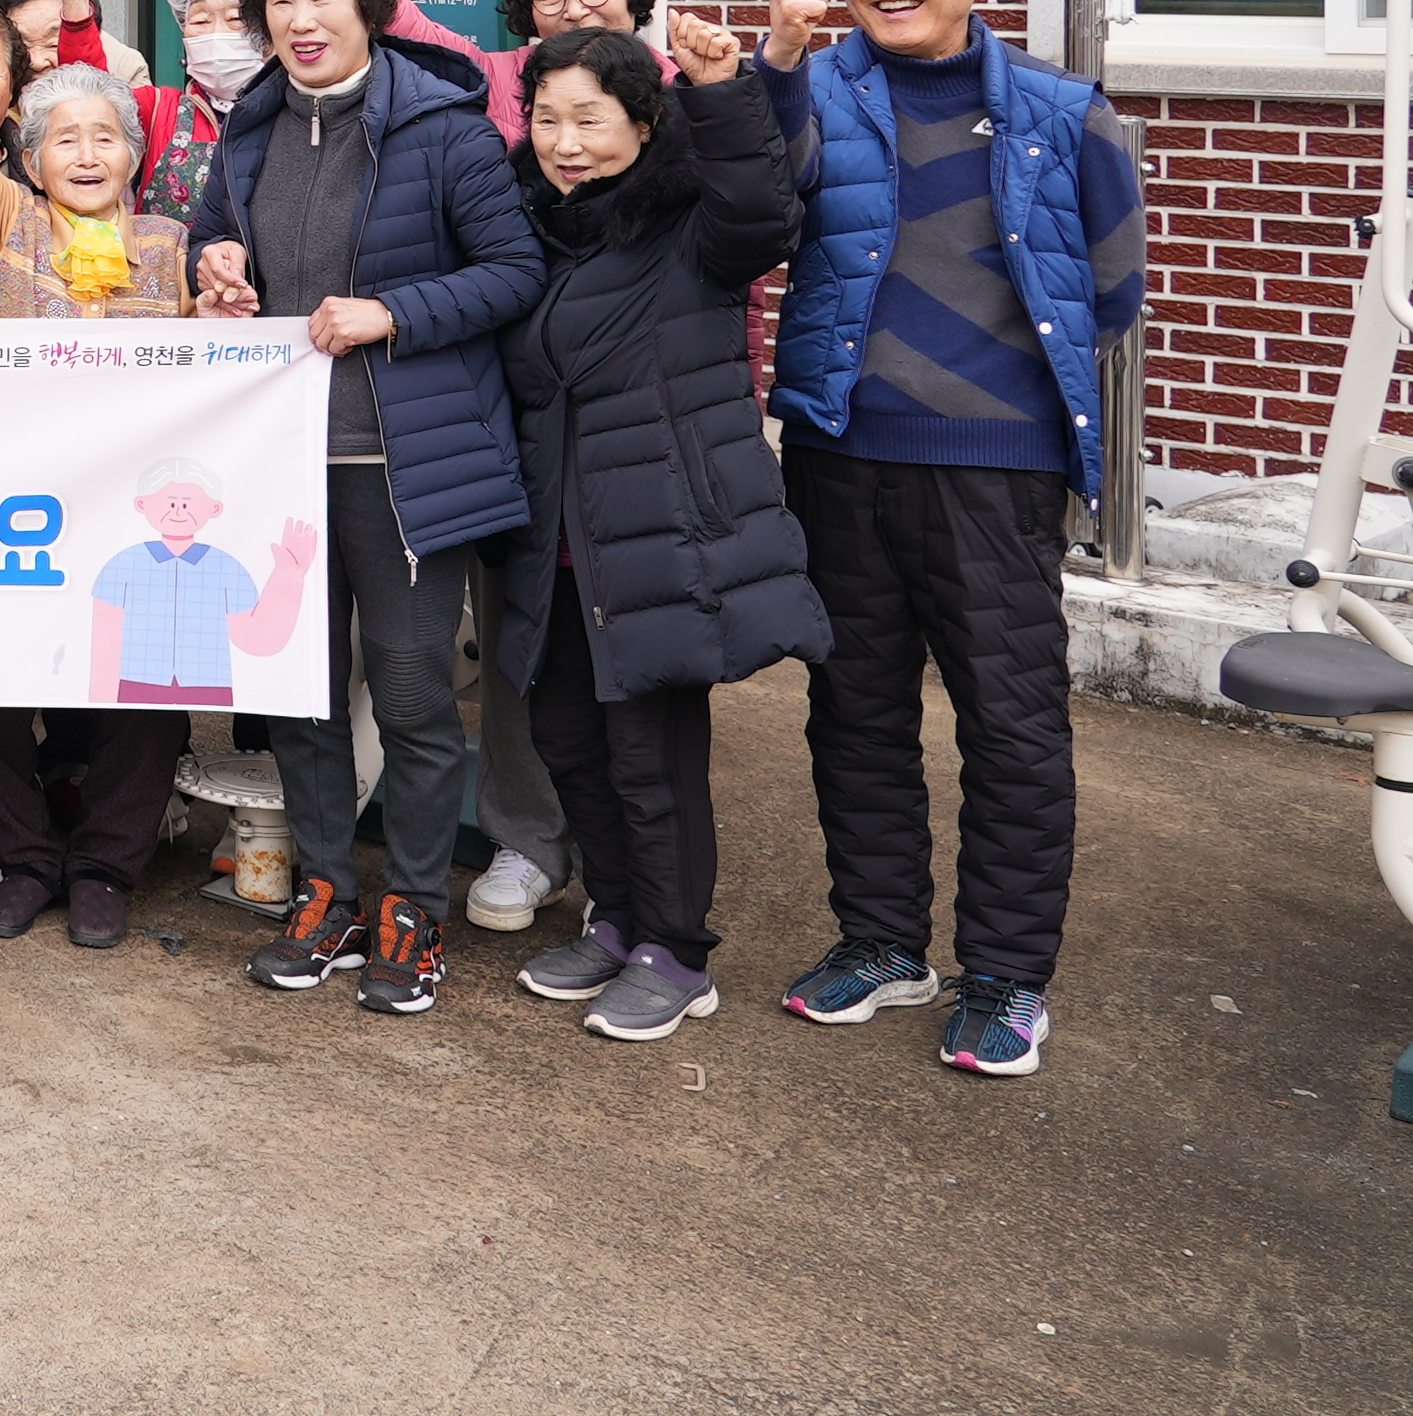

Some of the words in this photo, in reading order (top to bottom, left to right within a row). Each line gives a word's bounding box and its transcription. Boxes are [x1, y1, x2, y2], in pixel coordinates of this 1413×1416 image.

[38, 340, 127, 369] 행복하게,
[134, 345, 195, 367] 영천을
[200, 342, 291, 365] 위대하게
